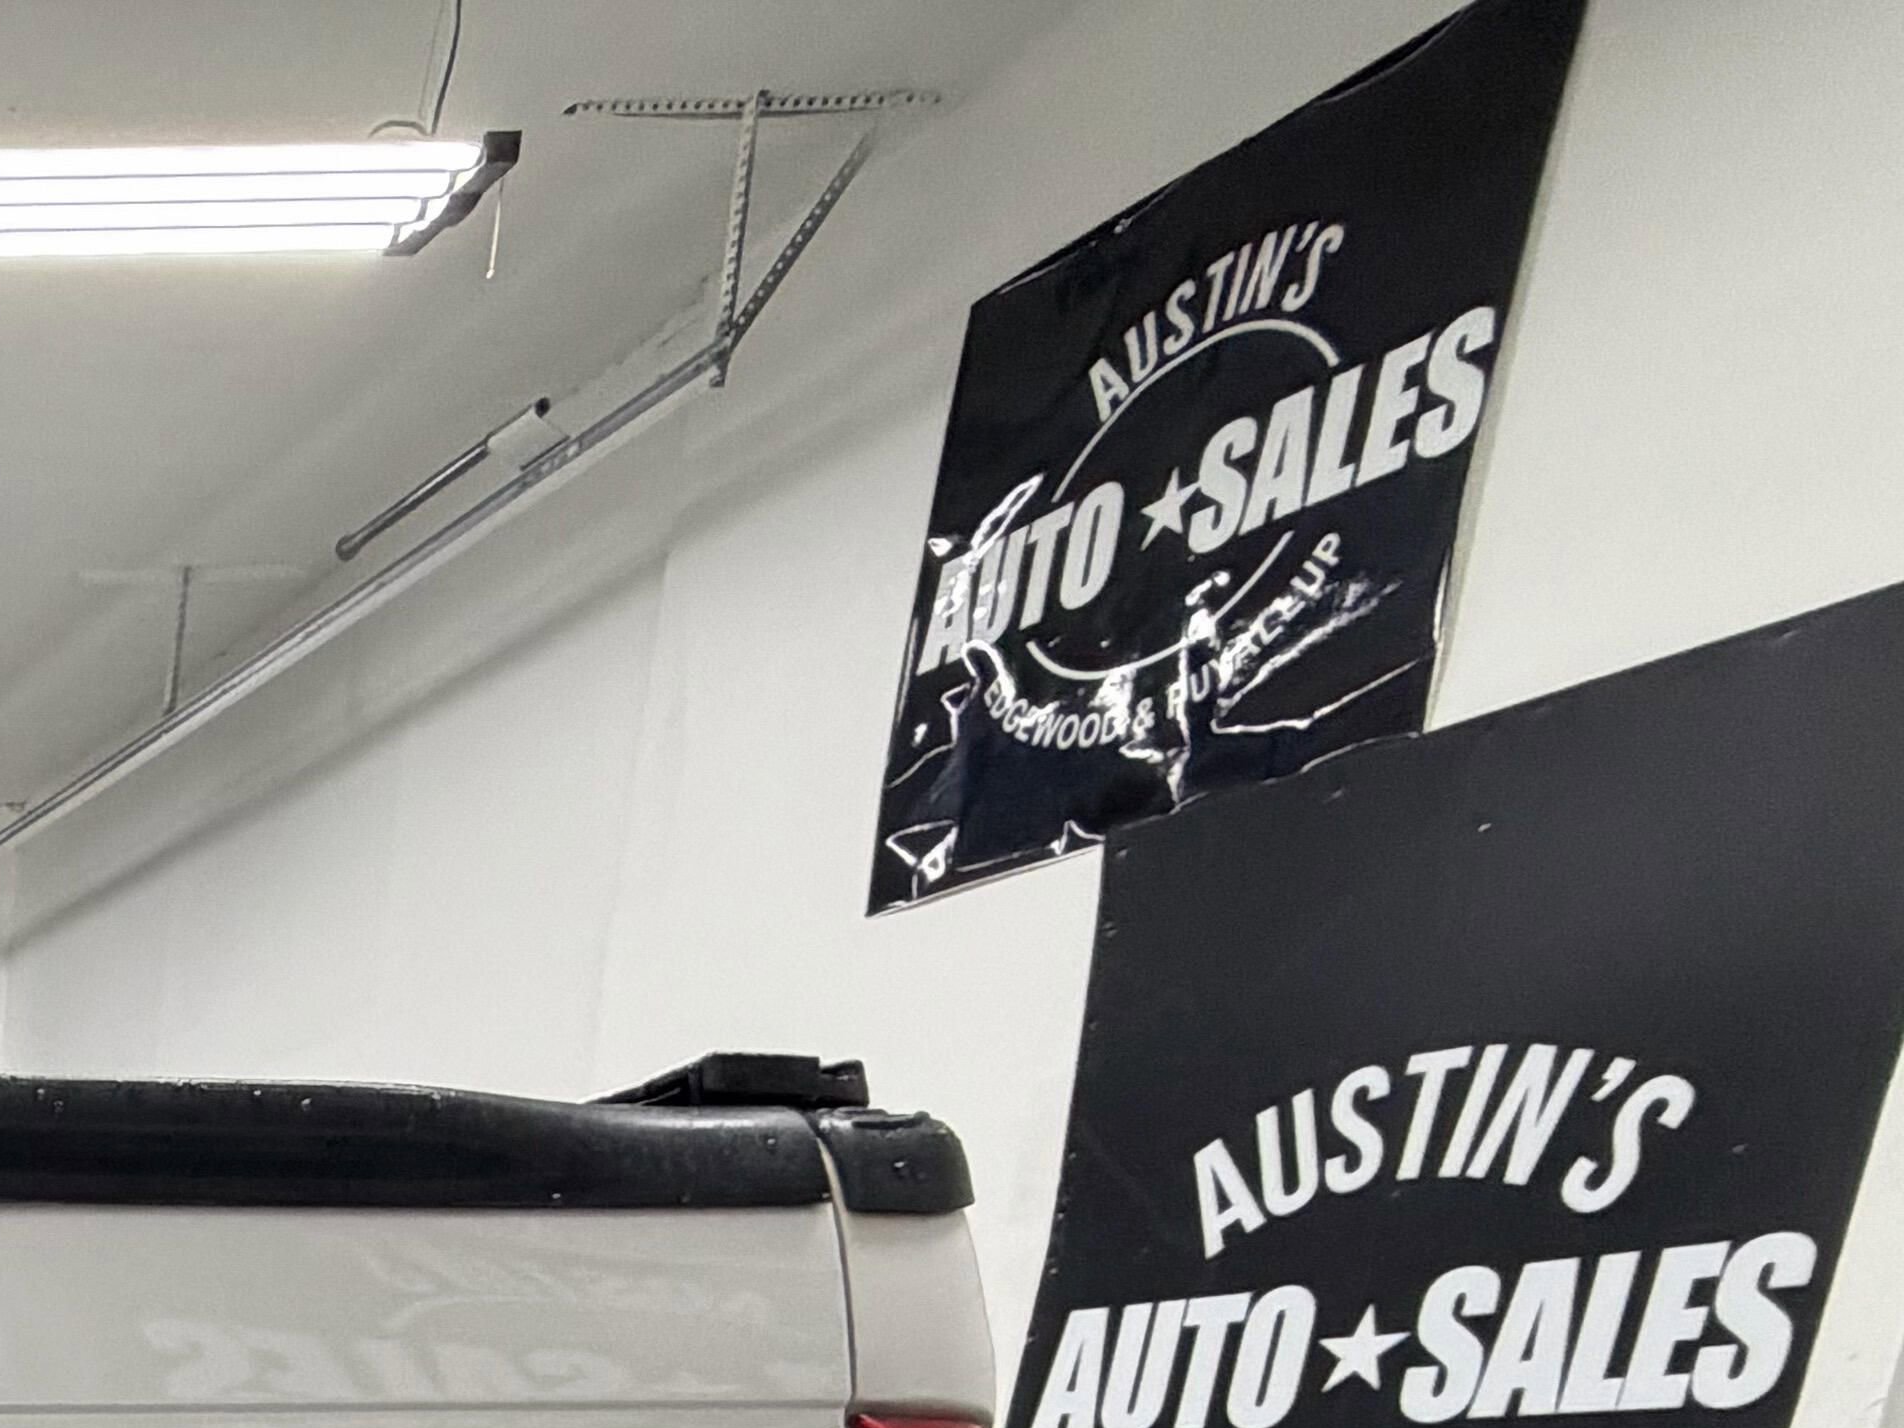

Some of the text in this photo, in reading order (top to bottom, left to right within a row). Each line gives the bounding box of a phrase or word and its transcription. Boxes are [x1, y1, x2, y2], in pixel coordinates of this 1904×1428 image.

[1087, 219, 1344, 422] AUSTIN'S
[916, 304, 1496, 676] AUTO SALES
[1132, 697, 1156, 738] &
[1192, 1042, 1696, 1260] AUSTIN'S
[1399, 1231, 1817, 1424] SALES
